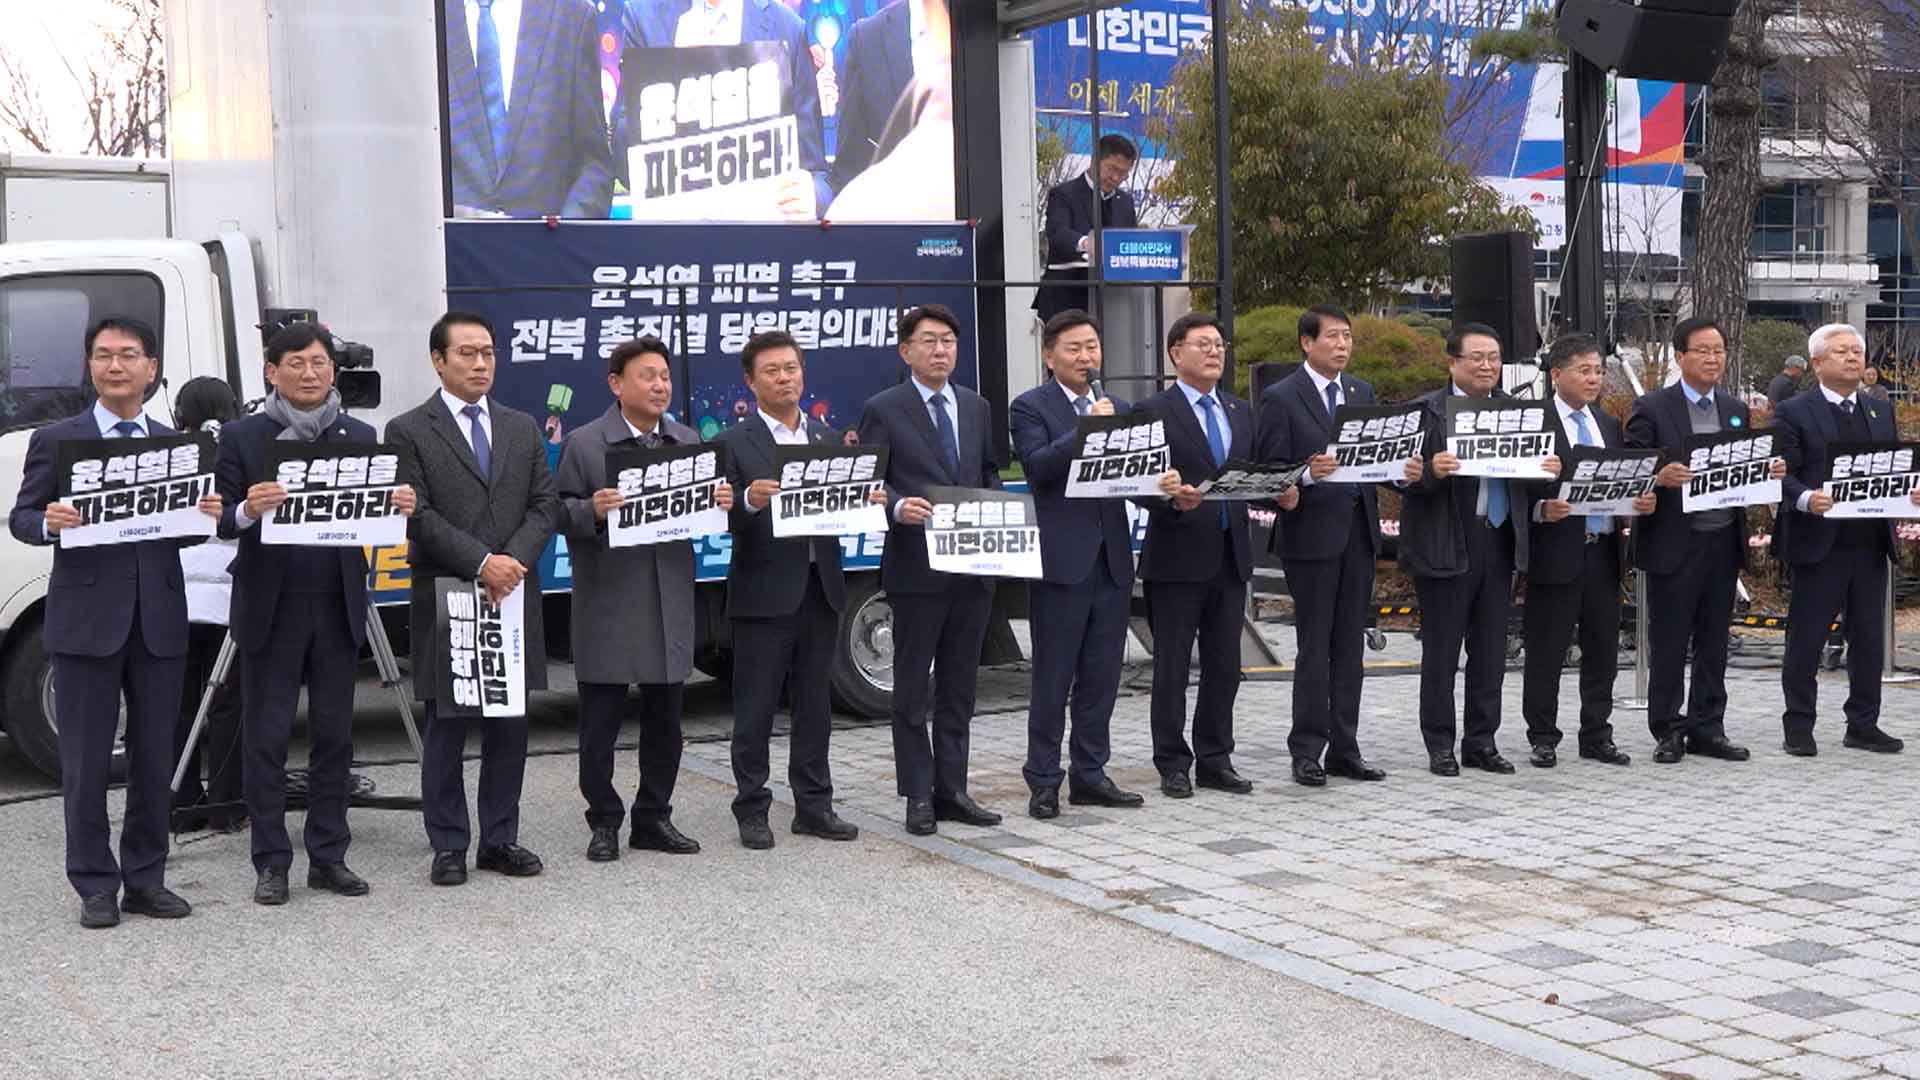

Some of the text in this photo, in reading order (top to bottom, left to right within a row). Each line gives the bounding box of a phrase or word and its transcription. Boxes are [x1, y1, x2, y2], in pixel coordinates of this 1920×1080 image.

[639, 60, 782, 142] 윤석열을
[643, 126, 794, 199] 파면하라!
[592, 260, 856, 307] 윤석열 파면 촉구
[511, 317, 587, 362] 전북
[1082, 420, 1165, 456] 윤석열을
[1338, 410, 1421, 442] 윤석열을
[1455, 408, 1544, 433] 윤석열을
[1335, 435, 1422, 467] 파면하라!
[1456, 435, 1552, 460] 파면하라!
[1689, 435, 1773, 471] 윤석열을
[1832, 448, 1913, 478] 윤석열을
[71, 443, 200, 493] 윤석열을
[276, 454, 398, 491] 윤석열을
[617, 450, 717, 497] 윤석열을
[780, 454, 878, 489] 윤석열을
[1573, 456, 1658, 480] 윤석열을
[931, 501, 1025, 529] 윤석열을
[935, 529, 1035, 555] 파면하라!
[447, 591, 480, 707] 윤석열을
